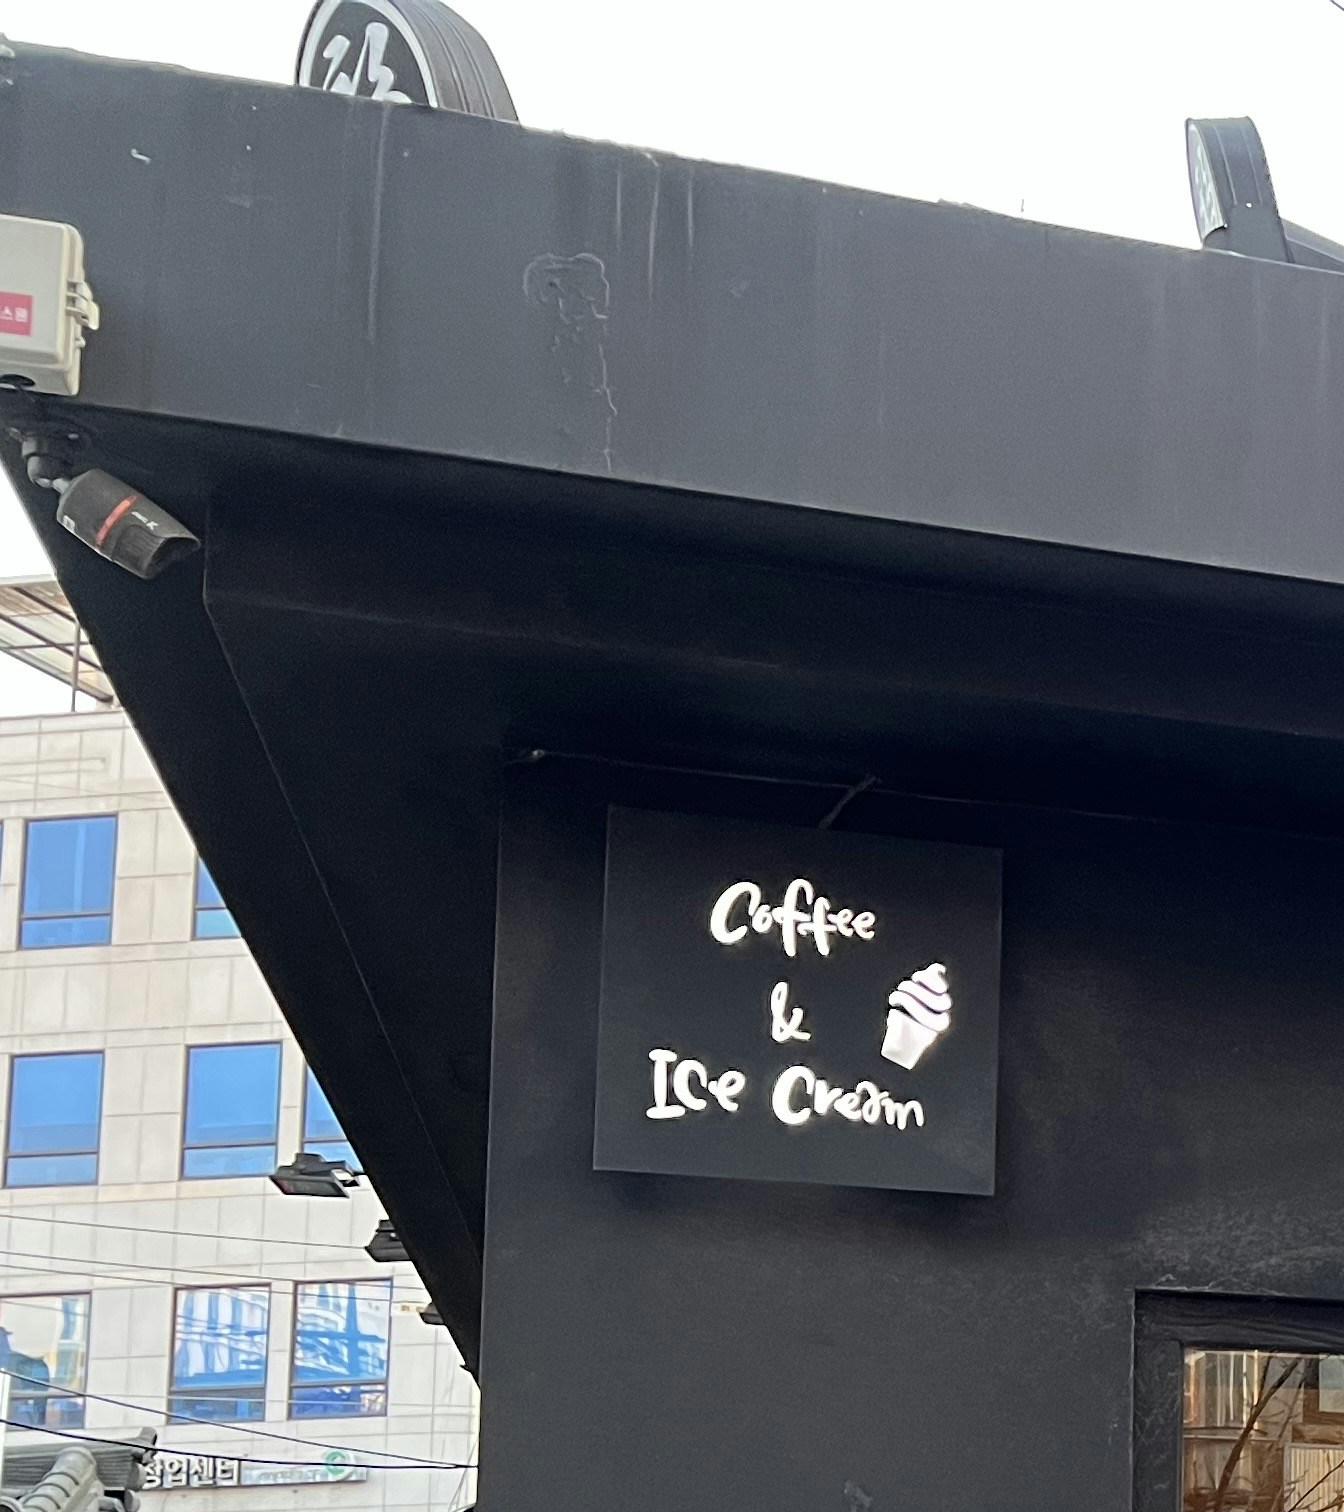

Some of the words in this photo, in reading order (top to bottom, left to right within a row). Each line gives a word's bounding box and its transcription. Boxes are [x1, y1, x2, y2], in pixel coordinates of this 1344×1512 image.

[710, 878, 876, 957] Coffee
[770, 982, 811, 1043] &
[645, 1049, 746, 1120] Ice
[772, 1065, 924, 1130] Cream
